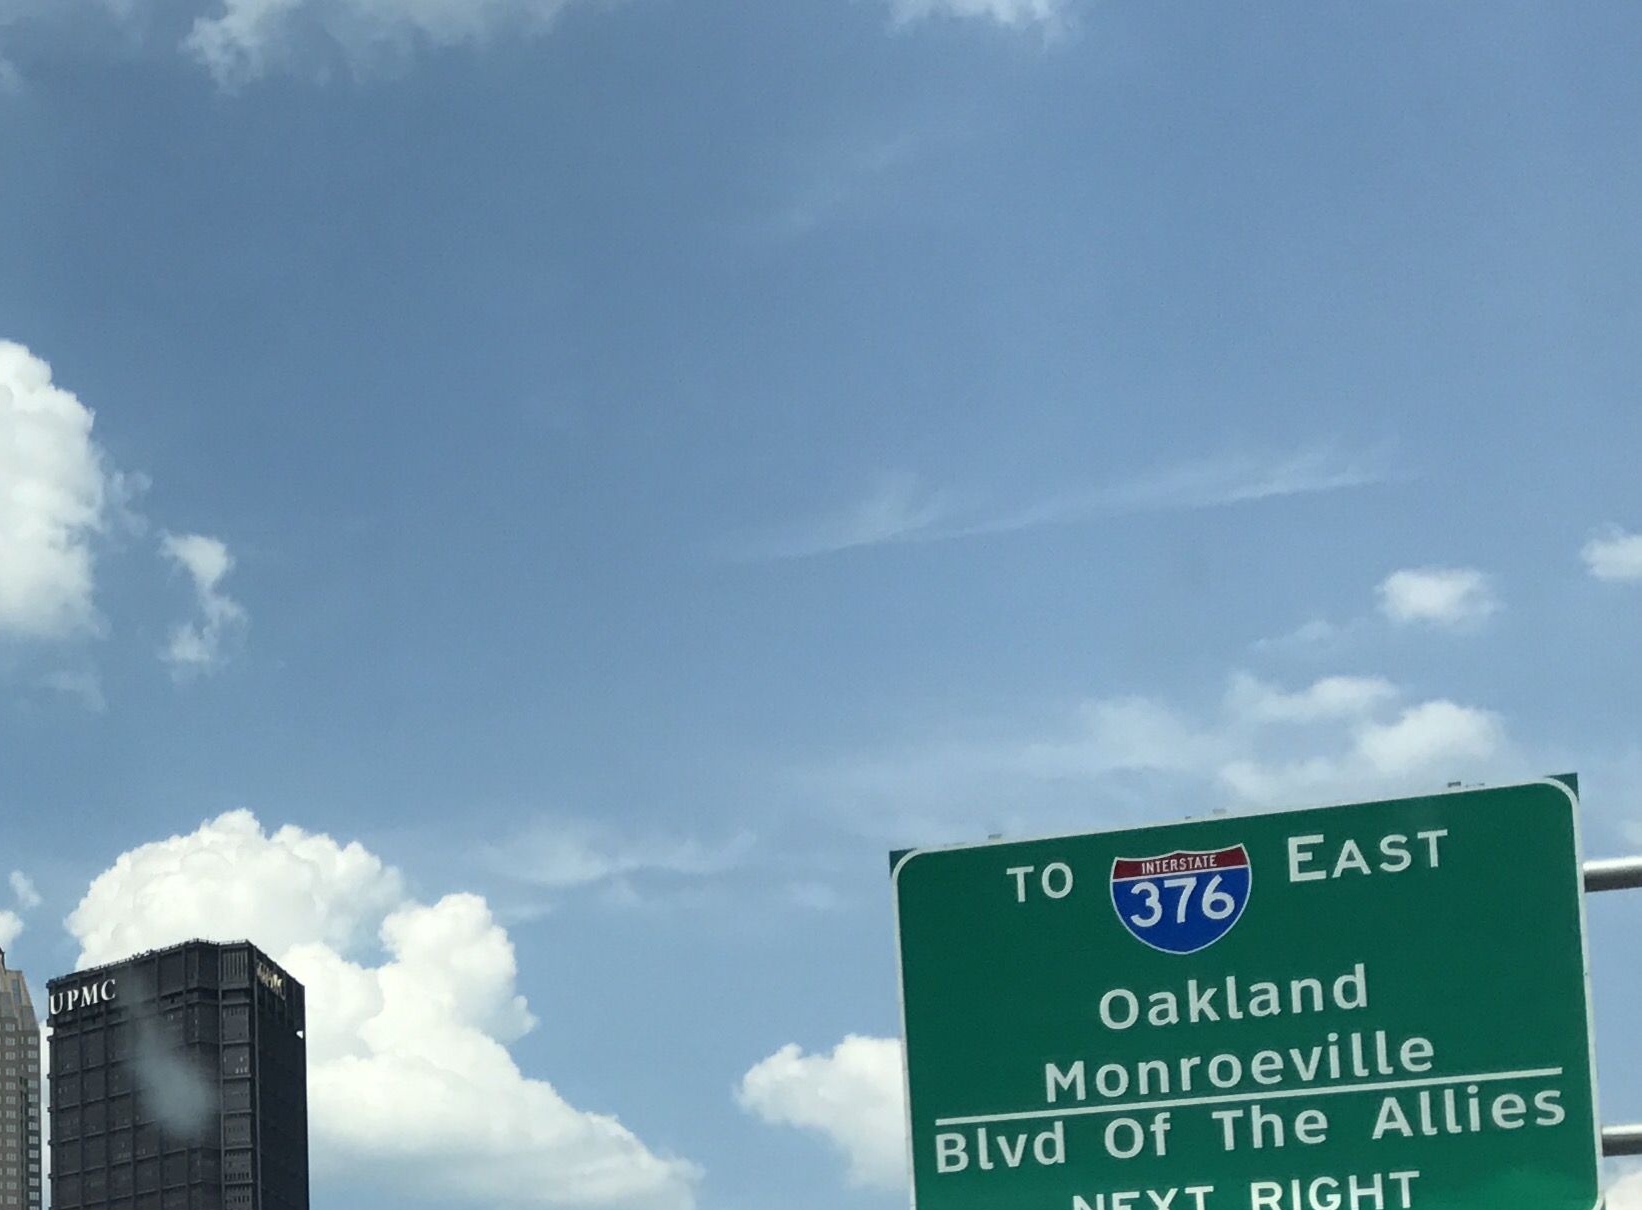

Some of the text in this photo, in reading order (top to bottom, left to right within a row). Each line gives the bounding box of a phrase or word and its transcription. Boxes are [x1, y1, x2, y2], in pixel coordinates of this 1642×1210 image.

[1007, 829, 1449, 903] TO EAST
[1141, 854, 1218, 875] INTERSTATE
[1129, 875, 1236, 928] 376
[50, 978, 116, 1015] UPMC
[1099, 963, 1369, 1030] Oakland
[1045, 1030, 1435, 1103] Monroeville
[935, 1084, 1567, 1174] Blvd Of The Allies
